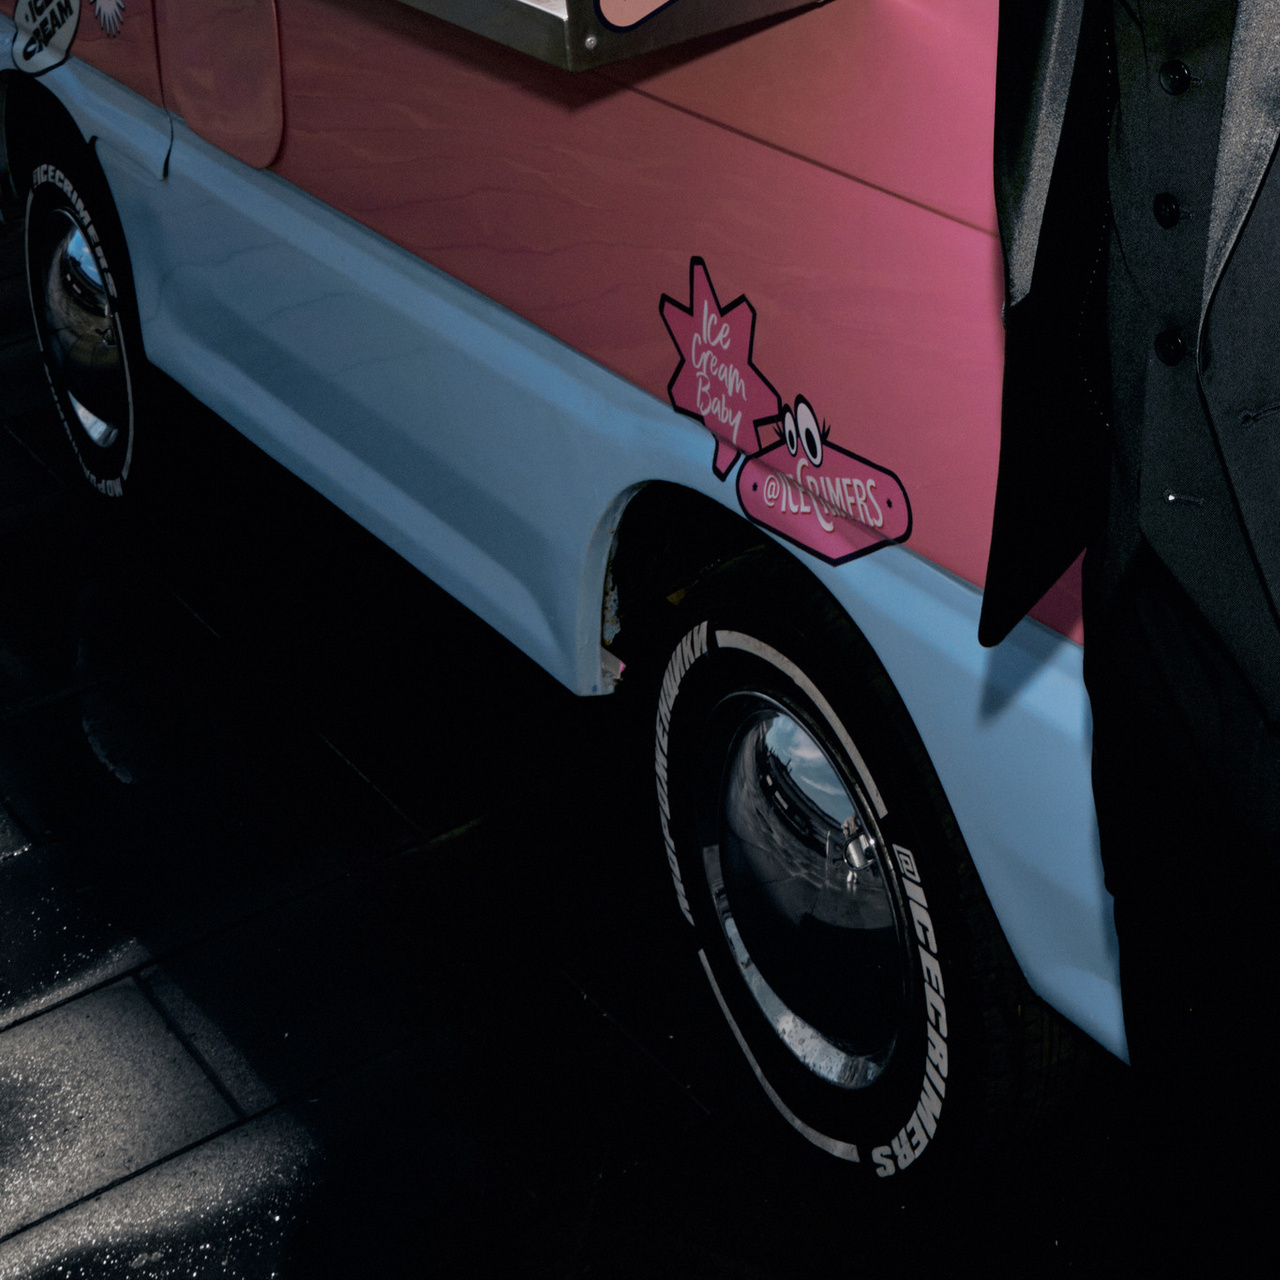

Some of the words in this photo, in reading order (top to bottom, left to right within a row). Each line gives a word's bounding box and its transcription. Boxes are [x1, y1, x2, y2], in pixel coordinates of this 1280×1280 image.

[702, 299, 731, 350] Ice
[691, 332, 748, 402] Cream
[696, 371, 742, 445] Baby
[870, 842, 949, 1178] @ICECRIMERS
